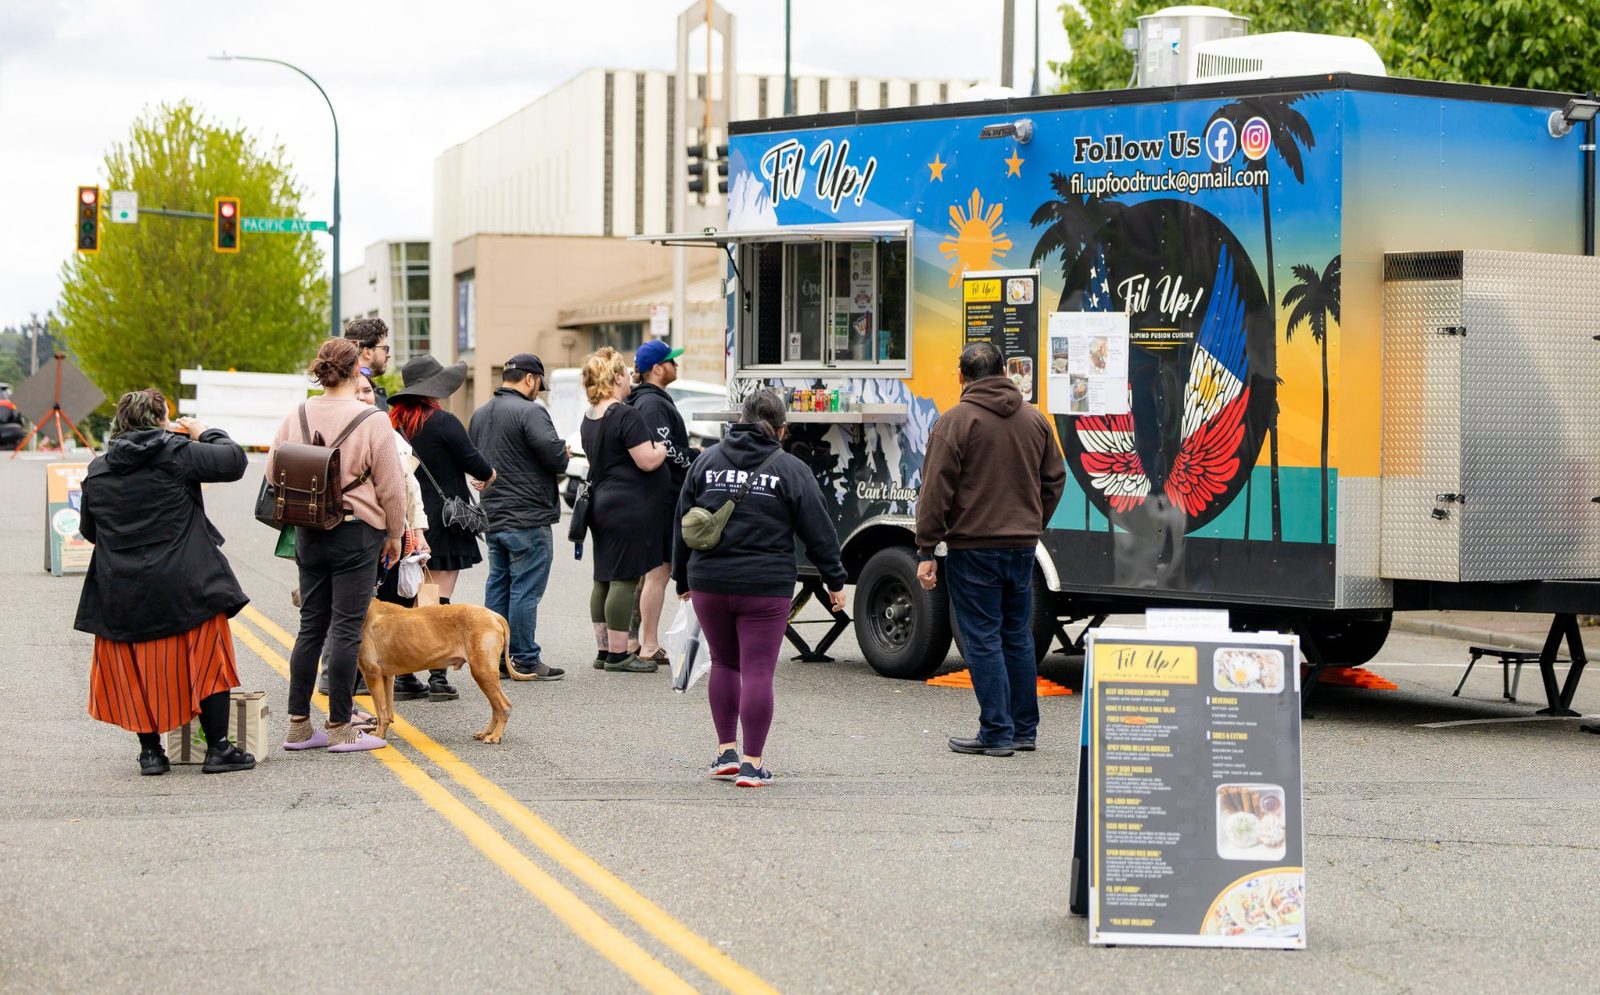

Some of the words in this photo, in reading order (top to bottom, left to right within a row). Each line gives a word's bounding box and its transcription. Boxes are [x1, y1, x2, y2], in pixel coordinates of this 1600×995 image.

[1074, 135, 1164, 163] Follow
[1168, 131, 1200, 159] Us
[760, 139, 806, 207] Fil
[810, 139, 877, 213] Up!
[1071, 166, 1269, 197] fil.upfoodtruck@gmail.com
[243, 218, 284, 231] PACIFIC
[291, 219, 311, 232] AVE
[1117, 274, 1150, 313] Fil
[1155, 274, 1204, 322] Up!
[890, 481, 918, 501] have
